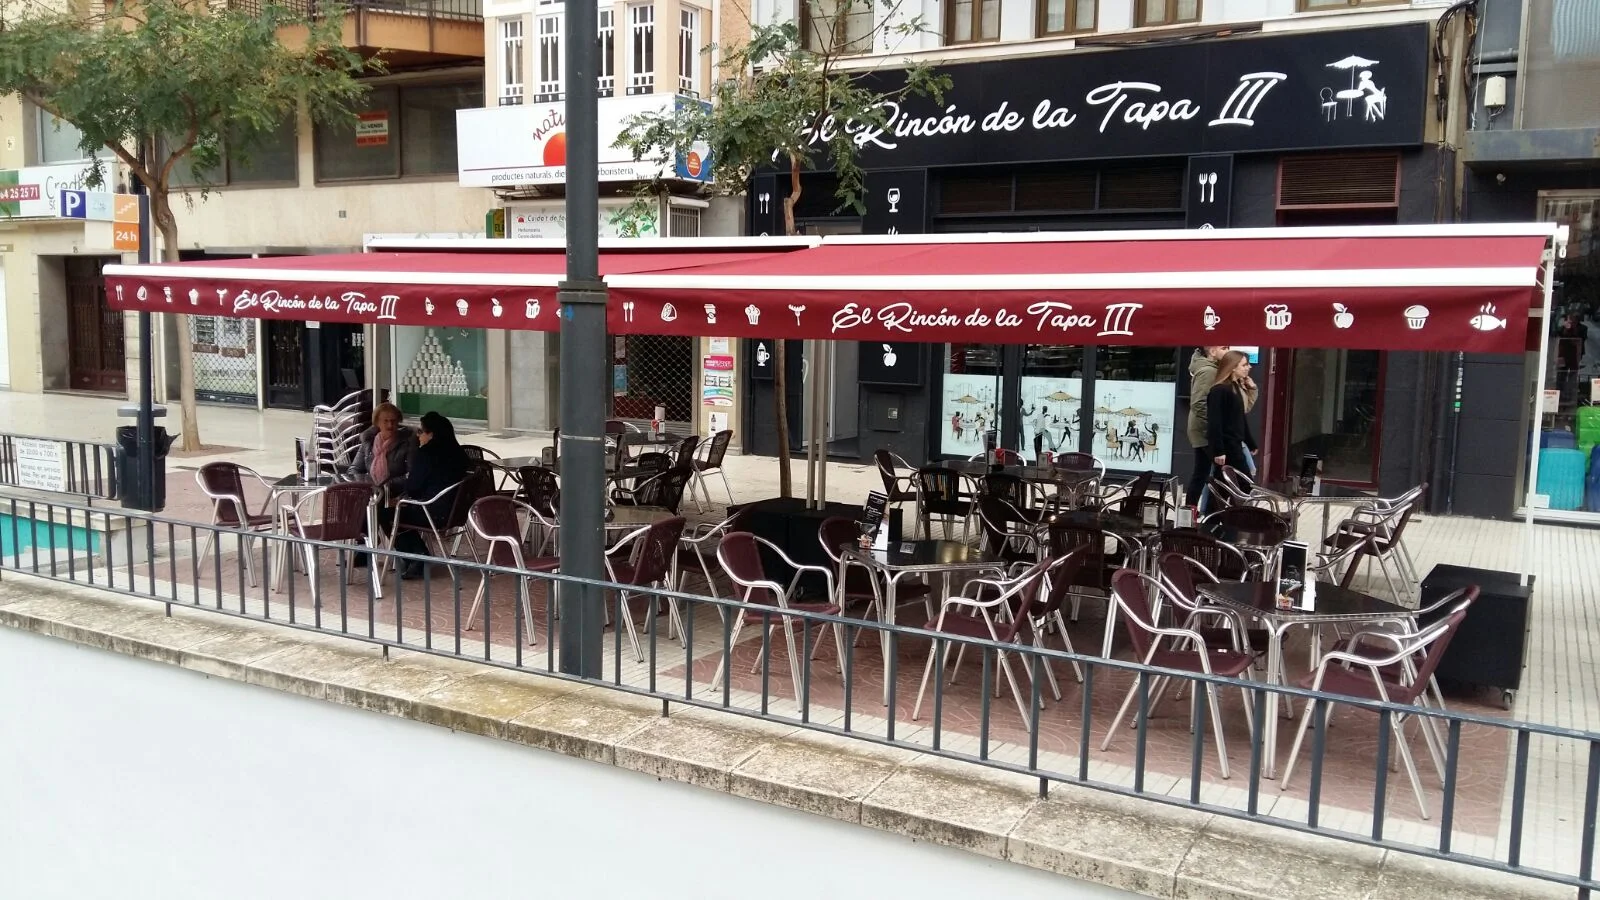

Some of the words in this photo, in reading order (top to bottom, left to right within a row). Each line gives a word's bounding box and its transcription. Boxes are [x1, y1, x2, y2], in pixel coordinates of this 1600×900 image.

[845, 101, 976, 150] Rincón
[981, 101, 1025, 132] de
[1032, 99, 1077, 129] la
[1085, 80, 1200, 133] Tapa
[1207, 71, 1288, 127] III
[491, 171, 524, 183] productes
[65, 191, 81, 216] P
[116, 231, 129, 241] 24
[130, 231, 137, 242] h
[233, 289, 258, 313] El
[259, 290, 306, 313] Rincón
[308, 296, 323, 309] de
[324, 297, 340, 310] la
[341, 291, 377, 314] Tapa
[377, 295, 400, 320] III
[831, 302, 873, 334] El
[877, 302, 961, 333] Rincón
[964, 307, 992, 327] de
[995, 308, 1023, 327] la
[1026, 300, 1097, 332] Tapa
[1096, 302, 1144, 337] III
